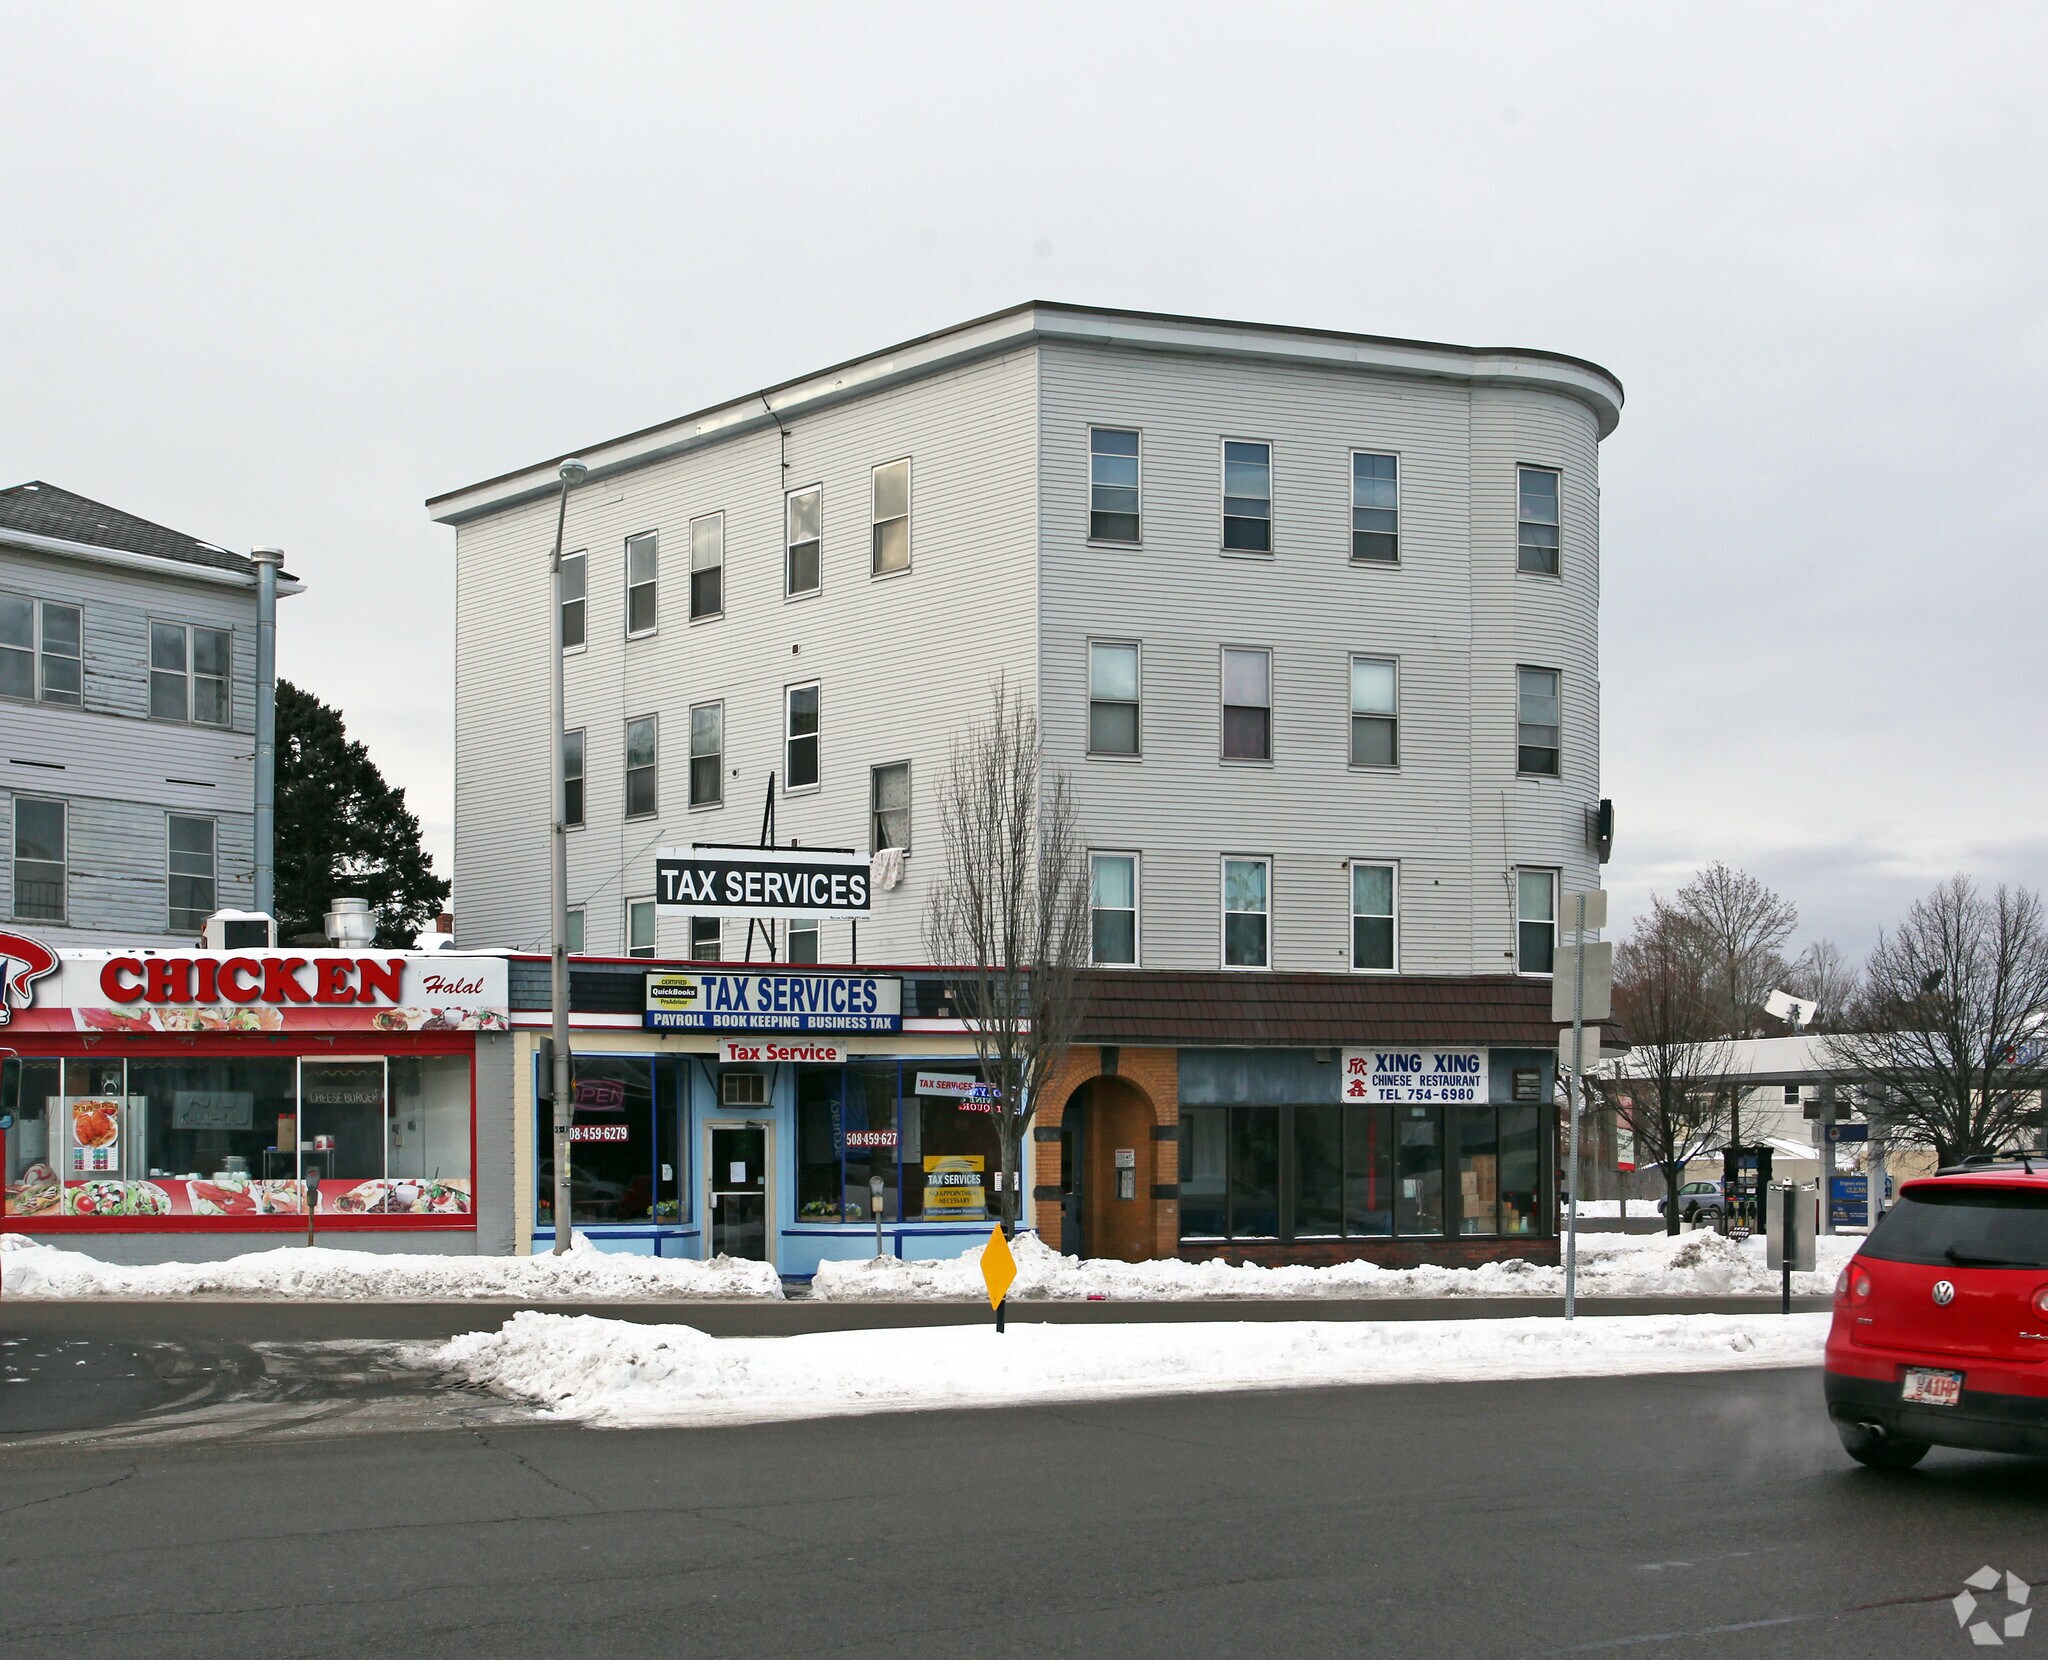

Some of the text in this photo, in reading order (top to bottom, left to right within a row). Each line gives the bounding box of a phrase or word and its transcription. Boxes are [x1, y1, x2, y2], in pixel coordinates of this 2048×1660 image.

[661, 869, 866, 906] TAX SERVICES
[99, 956, 406, 1004] CHICKEN
[423, 974, 484, 996] Halal
[652, 988, 695, 996] QuickBooks
[701, 976, 878, 1014] TAX SERVICES
[654, 1013, 892, 1030] PAYROLL BOOK KEEPING BUSINESS TAX
[727, 1043, 837, 1061] Tax Service
[1375, 1053, 1480, 1073] XING XING
[919, 1079, 935, 1089] TAX
[936, 1080, 973, 1091] SERVICES
[1372, 1074, 1481, 1087] CHINESE RESTAURANT
[309, 1090, 380, 1104] CHEESE BURGER
[1407, 1089, 1474, 1101] 754-6980
[928, 1174, 981, 1185] TAX SERVICES
